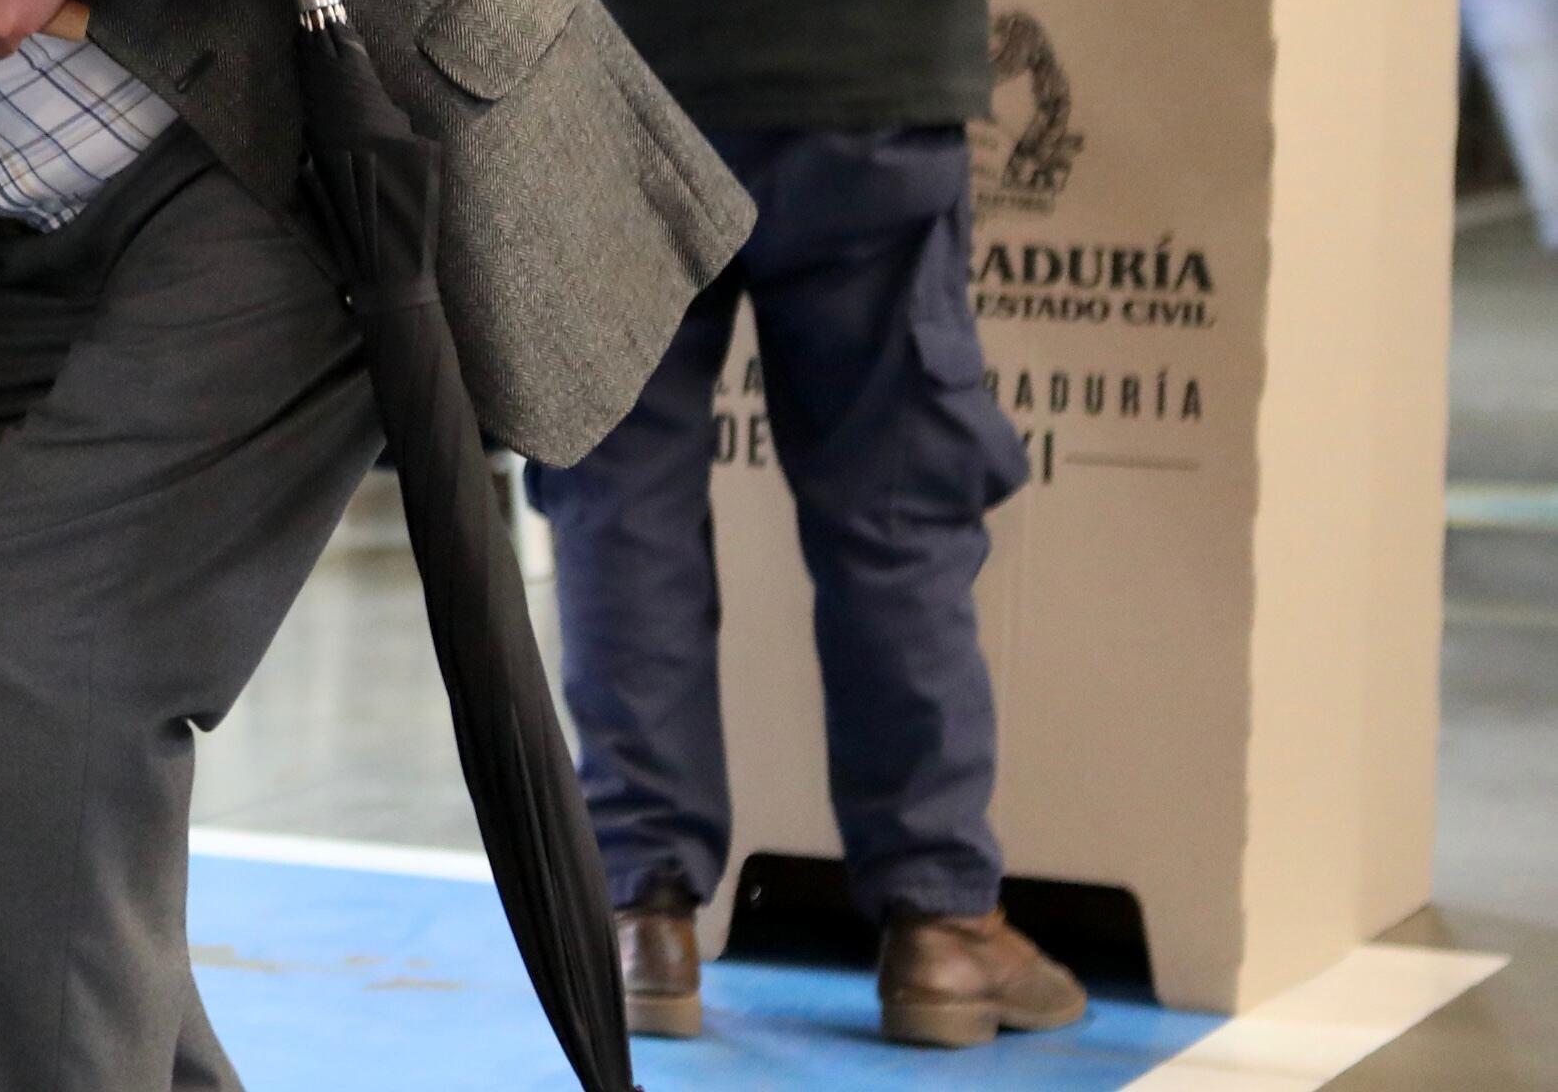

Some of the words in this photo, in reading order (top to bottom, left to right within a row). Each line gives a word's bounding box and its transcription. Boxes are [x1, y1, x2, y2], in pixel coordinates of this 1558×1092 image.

[969, 230, 1214, 295] ADURÍA
[976, 293, 1111, 324] ESTADO
[1121, 299, 1216, 328] CIVIL
